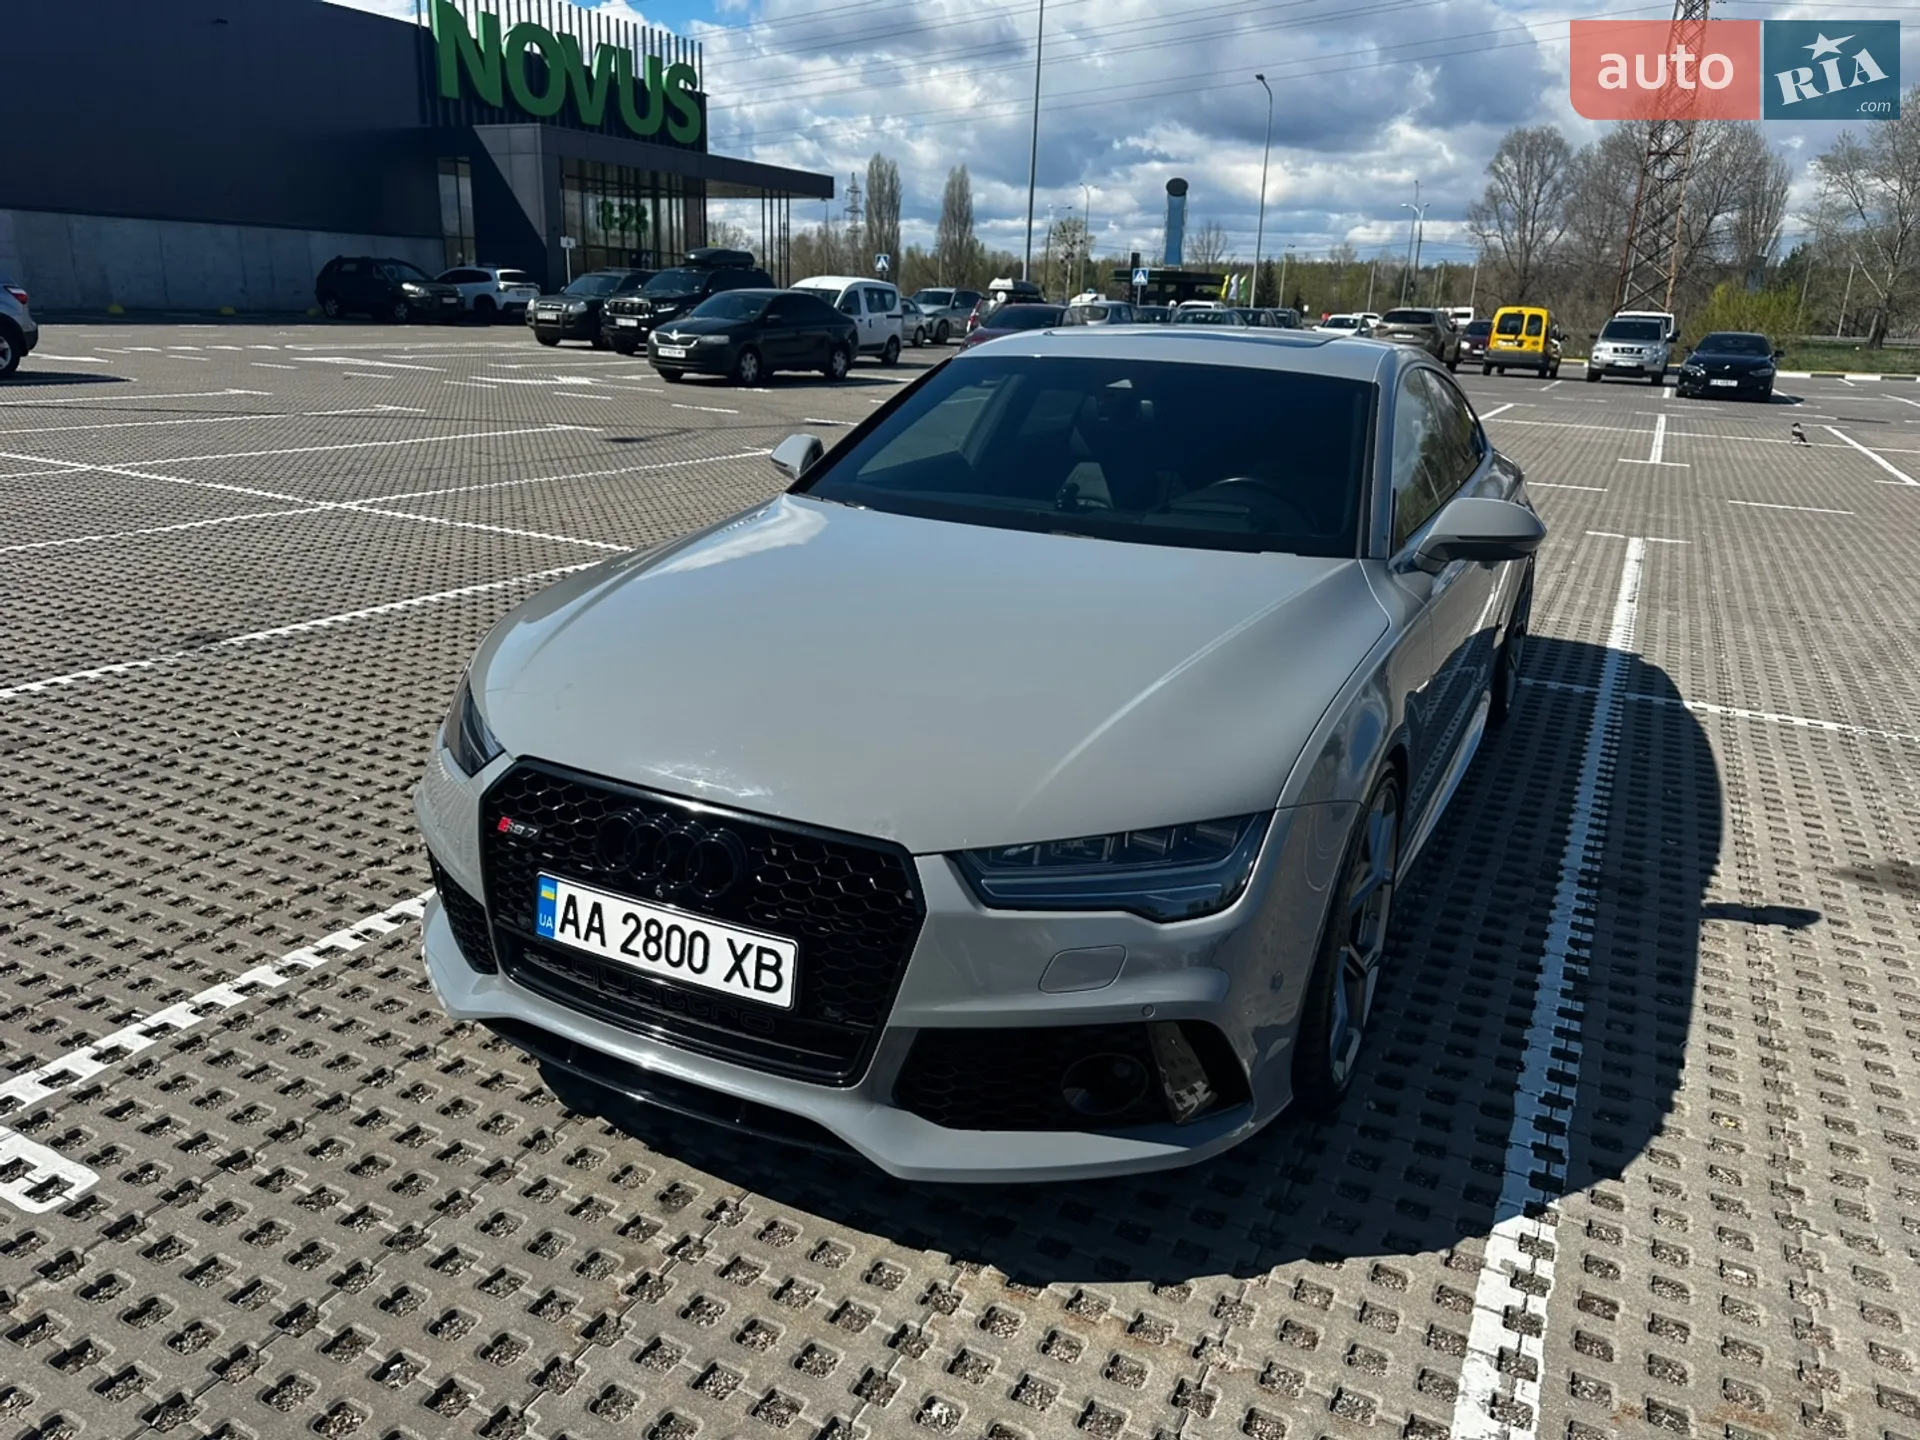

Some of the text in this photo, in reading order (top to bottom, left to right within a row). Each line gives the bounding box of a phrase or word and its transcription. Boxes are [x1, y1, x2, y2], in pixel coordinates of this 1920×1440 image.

[430, 0, 700, 143] NOVUS
[538, 912, 554, 929] UA
[558, 893, 784, 994] AA 2800 XB
